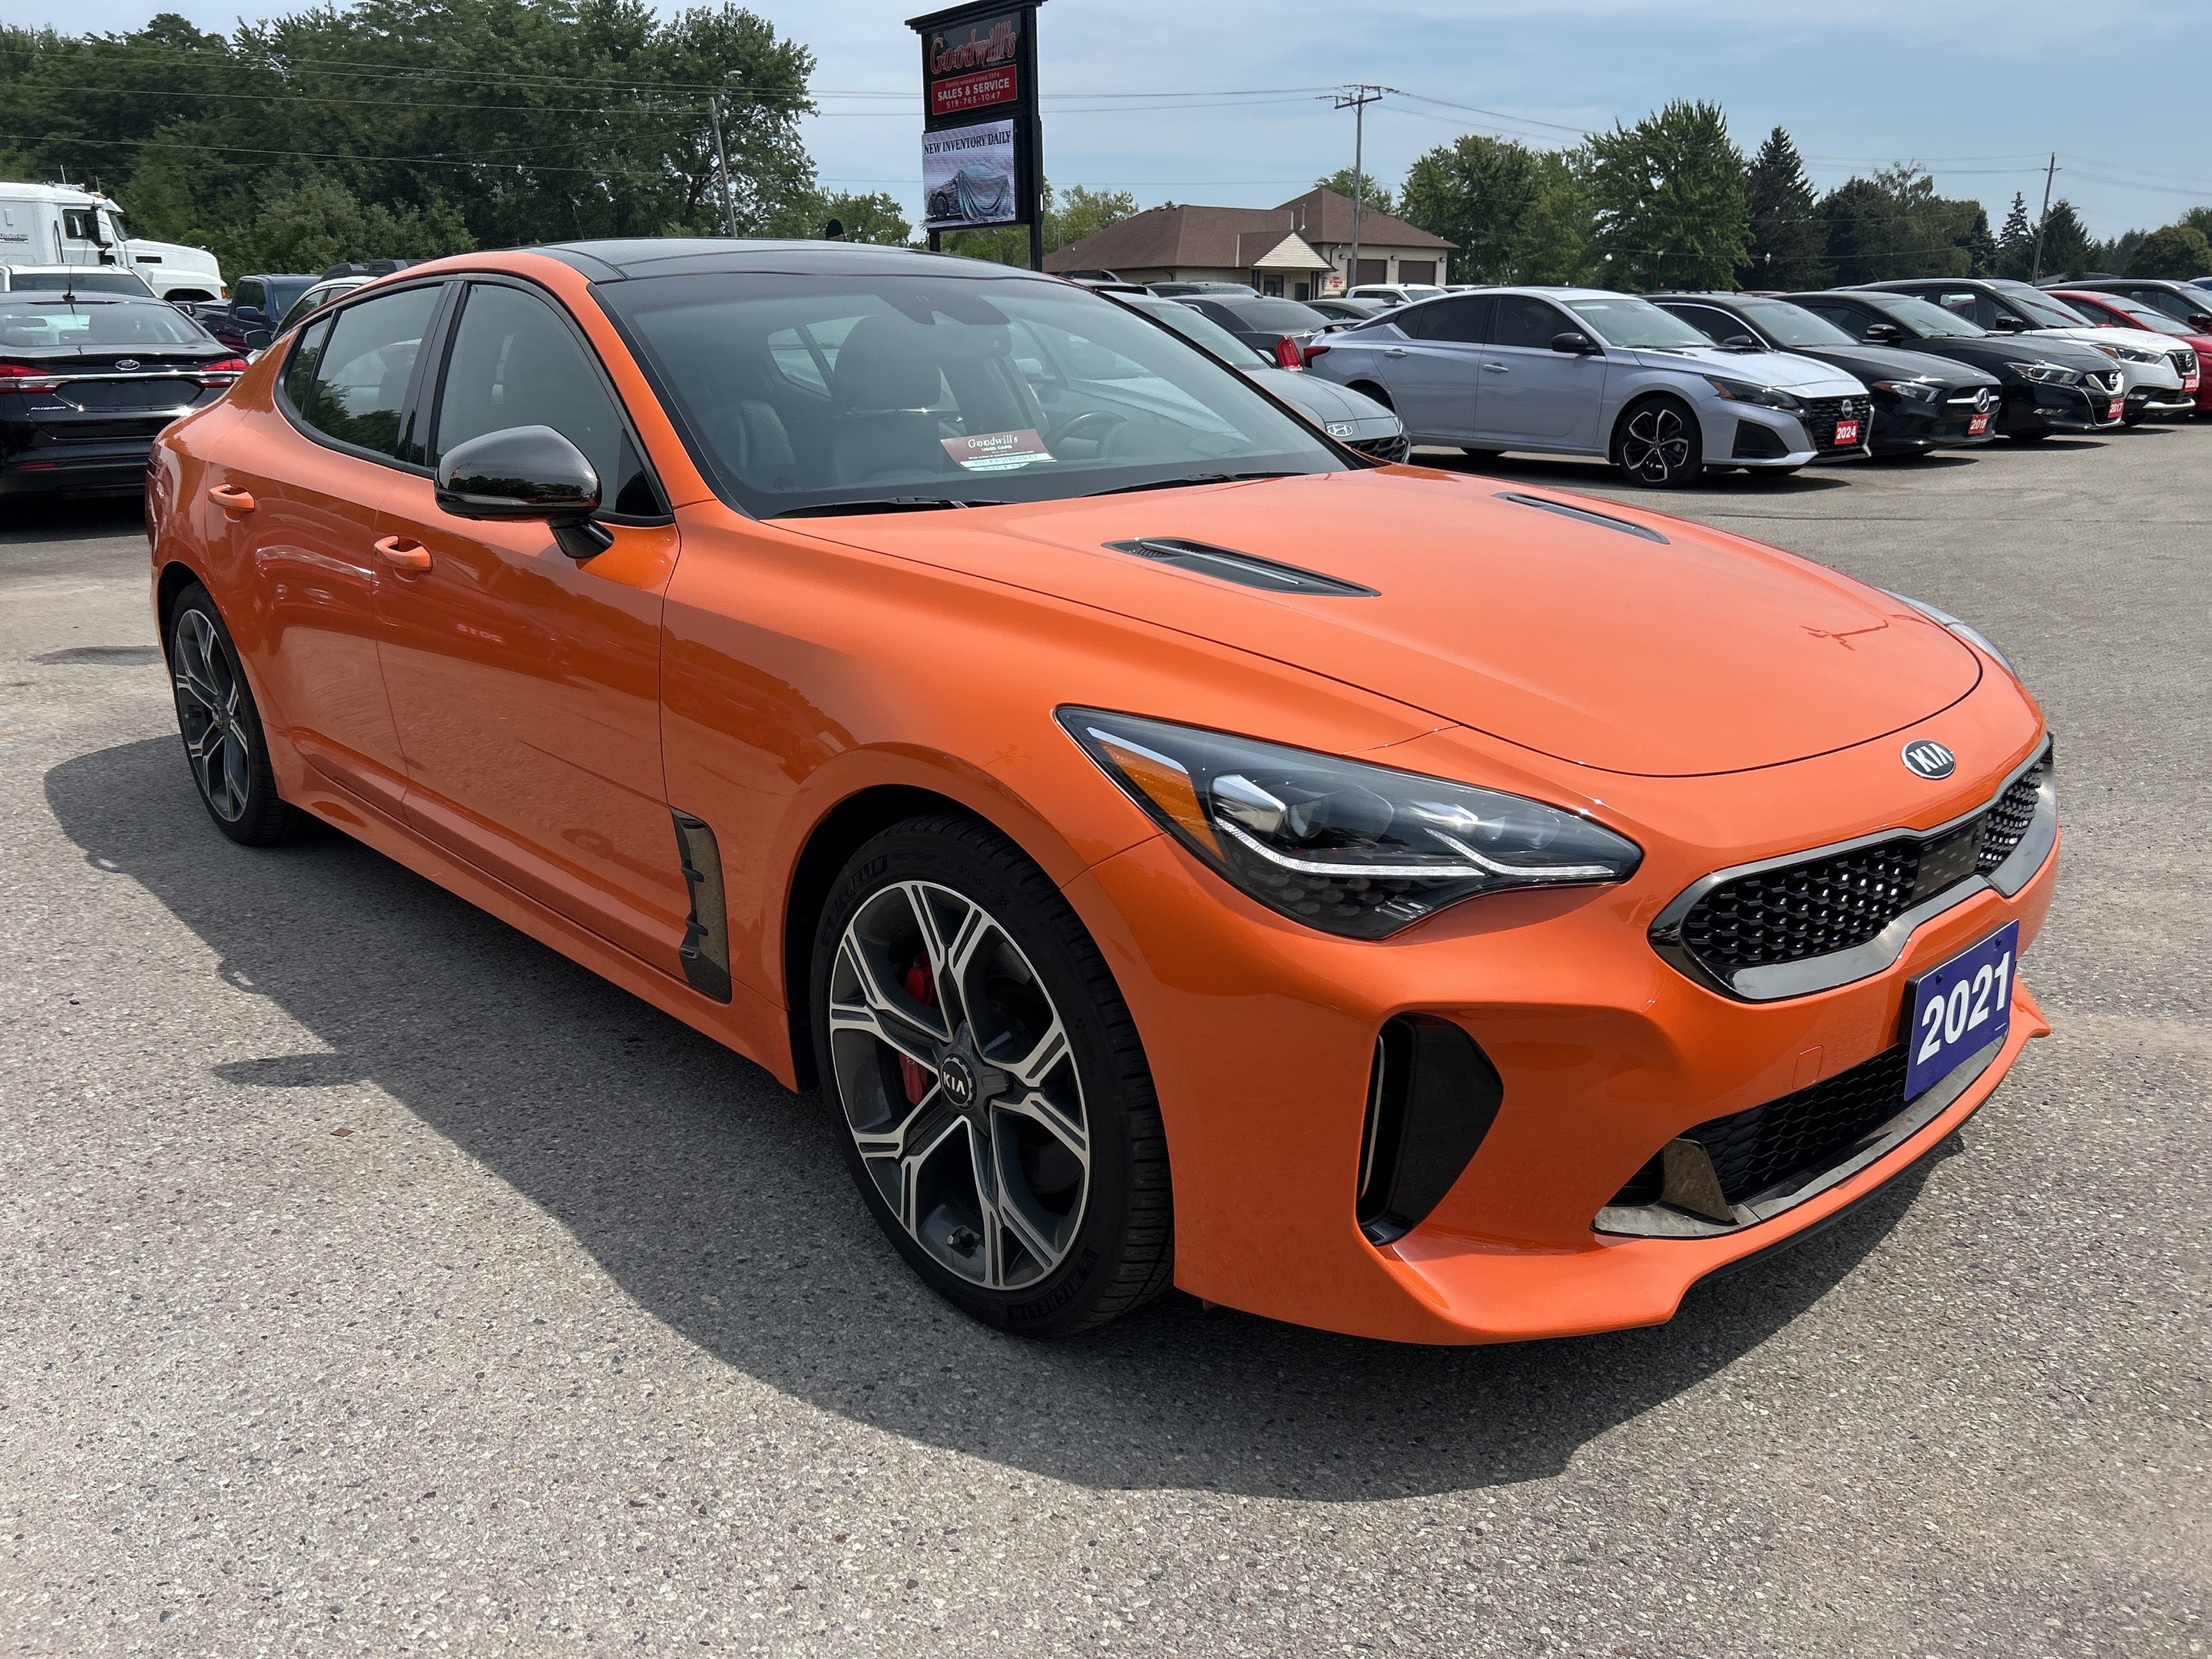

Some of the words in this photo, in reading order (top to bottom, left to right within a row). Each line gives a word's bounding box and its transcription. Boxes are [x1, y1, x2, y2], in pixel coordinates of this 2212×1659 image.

[930, 21, 1016, 75] Goodwill's
[938, 87, 962, 101] SALES
[965, 85, 971, 96] &
[973, 78, 1010, 94] SERVICE
[945, 91, 1000, 108] 519-765-1047
[924, 142, 942, 154] NEW
[942, 134, 988, 152] INVENTORY
[988, 131, 1012, 145] DAILY
[2109, 402, 2124, 413] 2017
[1836, 426, 1856, 439] 2024
[1970, 419, 1988, 430] 2019
[968, 435, 1018, 448] Goodwill's
[1907, 743, 1954, 773] KIA
[1916, 951, 2010, 1065] 2021
[943, 1071, 966, 1096] KIA
[1011, 1268, 1084, 1322] MICHELIN
